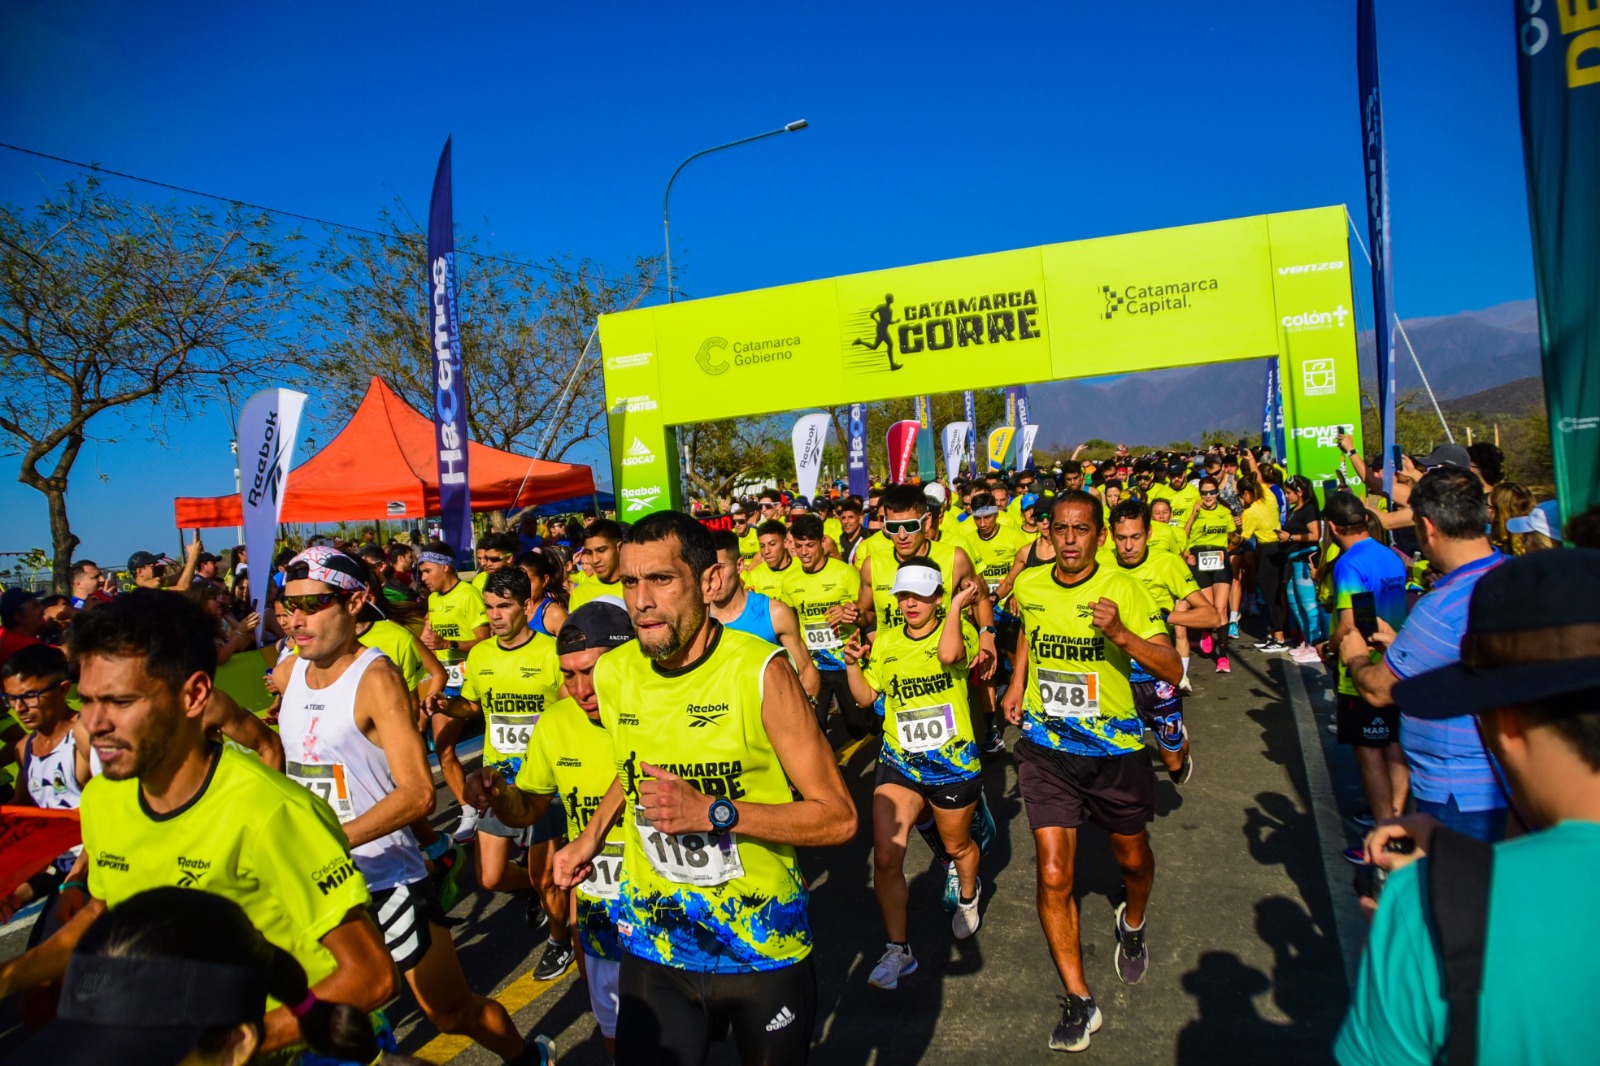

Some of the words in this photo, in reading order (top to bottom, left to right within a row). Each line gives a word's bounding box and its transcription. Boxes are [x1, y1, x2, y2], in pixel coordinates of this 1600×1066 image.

[1125, 279, 1218, 299] Catamarca
[904, 289, 1037, 321] CATAMARCA
[1126, 294, 1191, 315] Capital.
[898, 306, 1041, 354] CORRE
[733, 336, 800, 354] Catamarca
[734, 350, 792, 366] Gobierno
[610, 400, 657, 415] DEPORTES
[799, 423, 816, 468] Reebok
[248, 411, 277, 508] Reebok
[621, 455, 655, 466] ASOCAT
[621, 485, 660, 498] Reebok
[1201, 557, 1218, 566] 077
[808, 630, 831, 643] 081
[1043, 633, 1104, 646] CATAMARCA
[1039, 642, 1105, 662] CORRE
[495, 693, 544, 701] CATAMARCA
[901, 676, 954, 699] CORRE
[1040, 683, 1085, 707] 048
[494, 700, 545, 712] CORRE
[686, 702, 729, 713] Reebok
[496, 726, 530, 744] 166
[902, 720, 942, 742] 140
[647, 832, 709, 868] 118
[311, 857, 345, 881] Crédito
